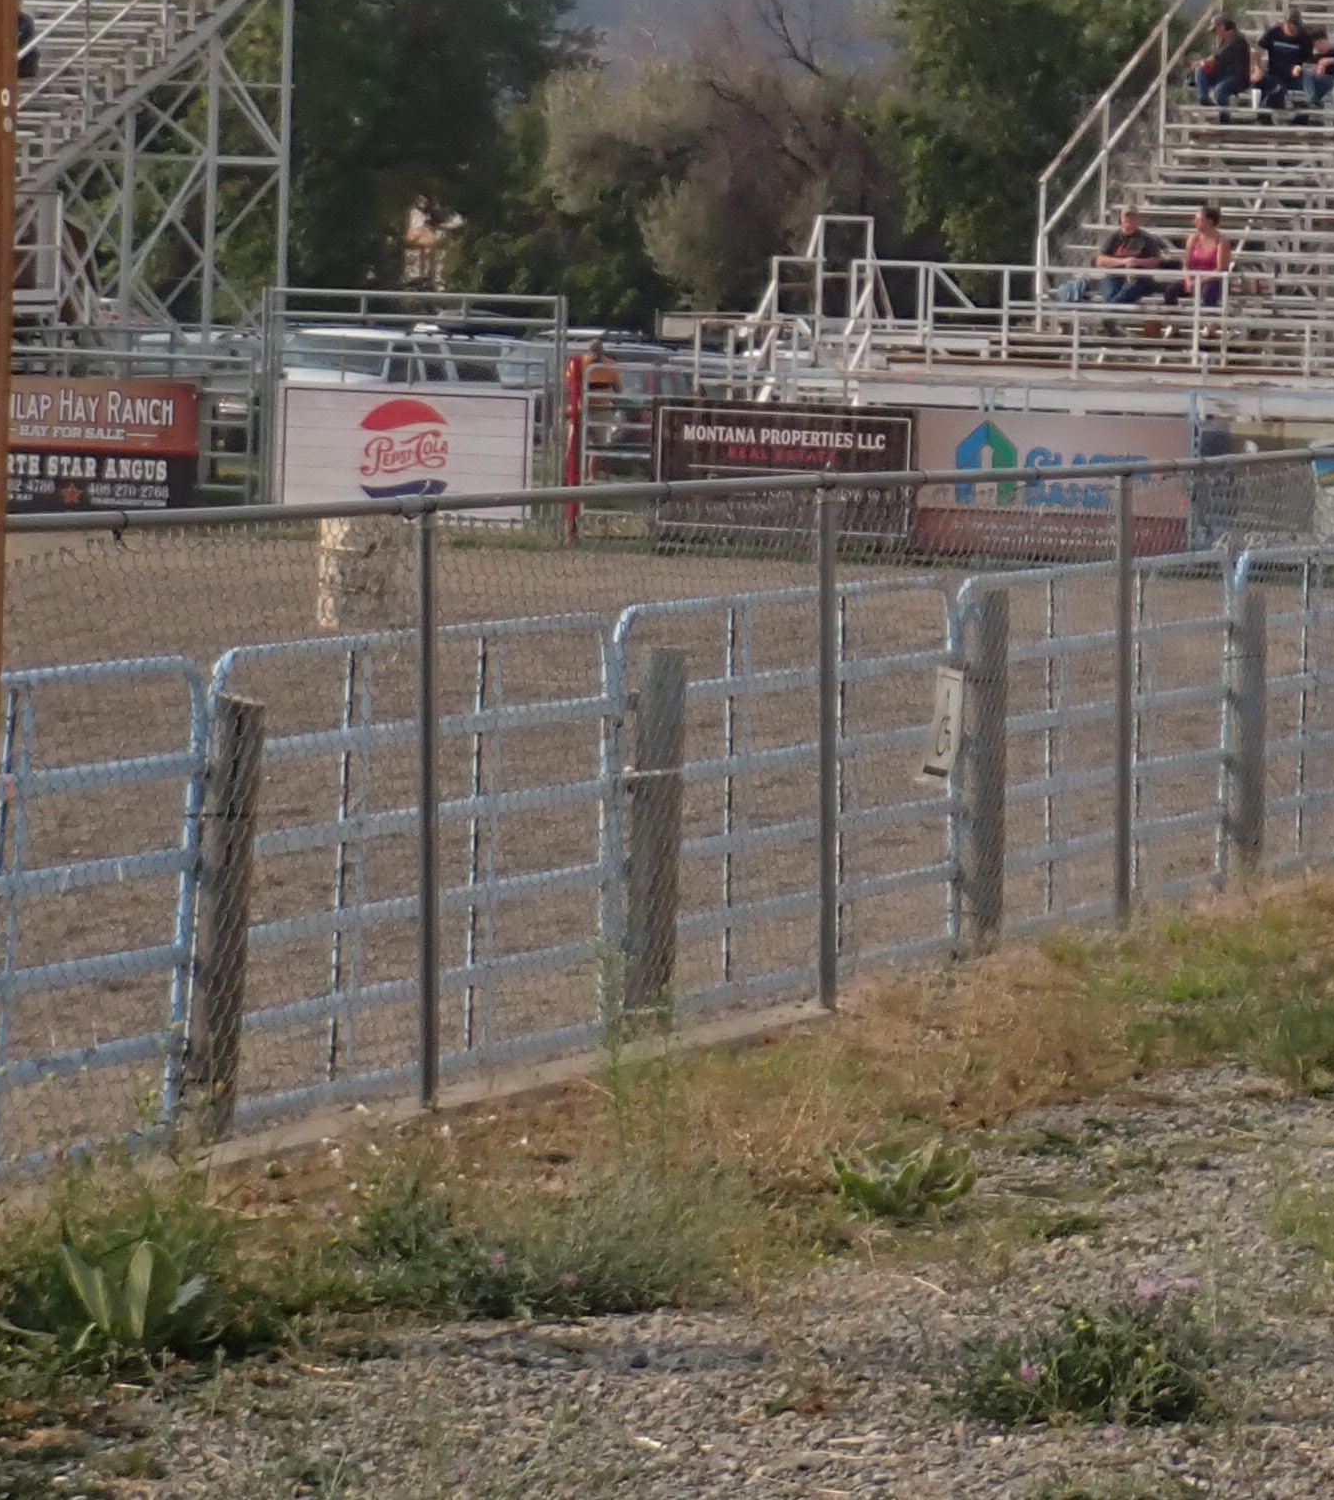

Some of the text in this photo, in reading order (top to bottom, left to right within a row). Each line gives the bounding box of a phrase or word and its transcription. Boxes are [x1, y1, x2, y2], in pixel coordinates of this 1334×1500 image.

[58, 388, 100, 423] HAY
[107, 390, 175, 426] RANCH
[53, 426, 82, 439] FOR
[84, 426, 125, 440] SALE
[683, 424, 886, 450] MONTANA PROPERTIES LLC
[47, 454, 97, 478] STAR
[104, 457, 168, 482] ANGUS
